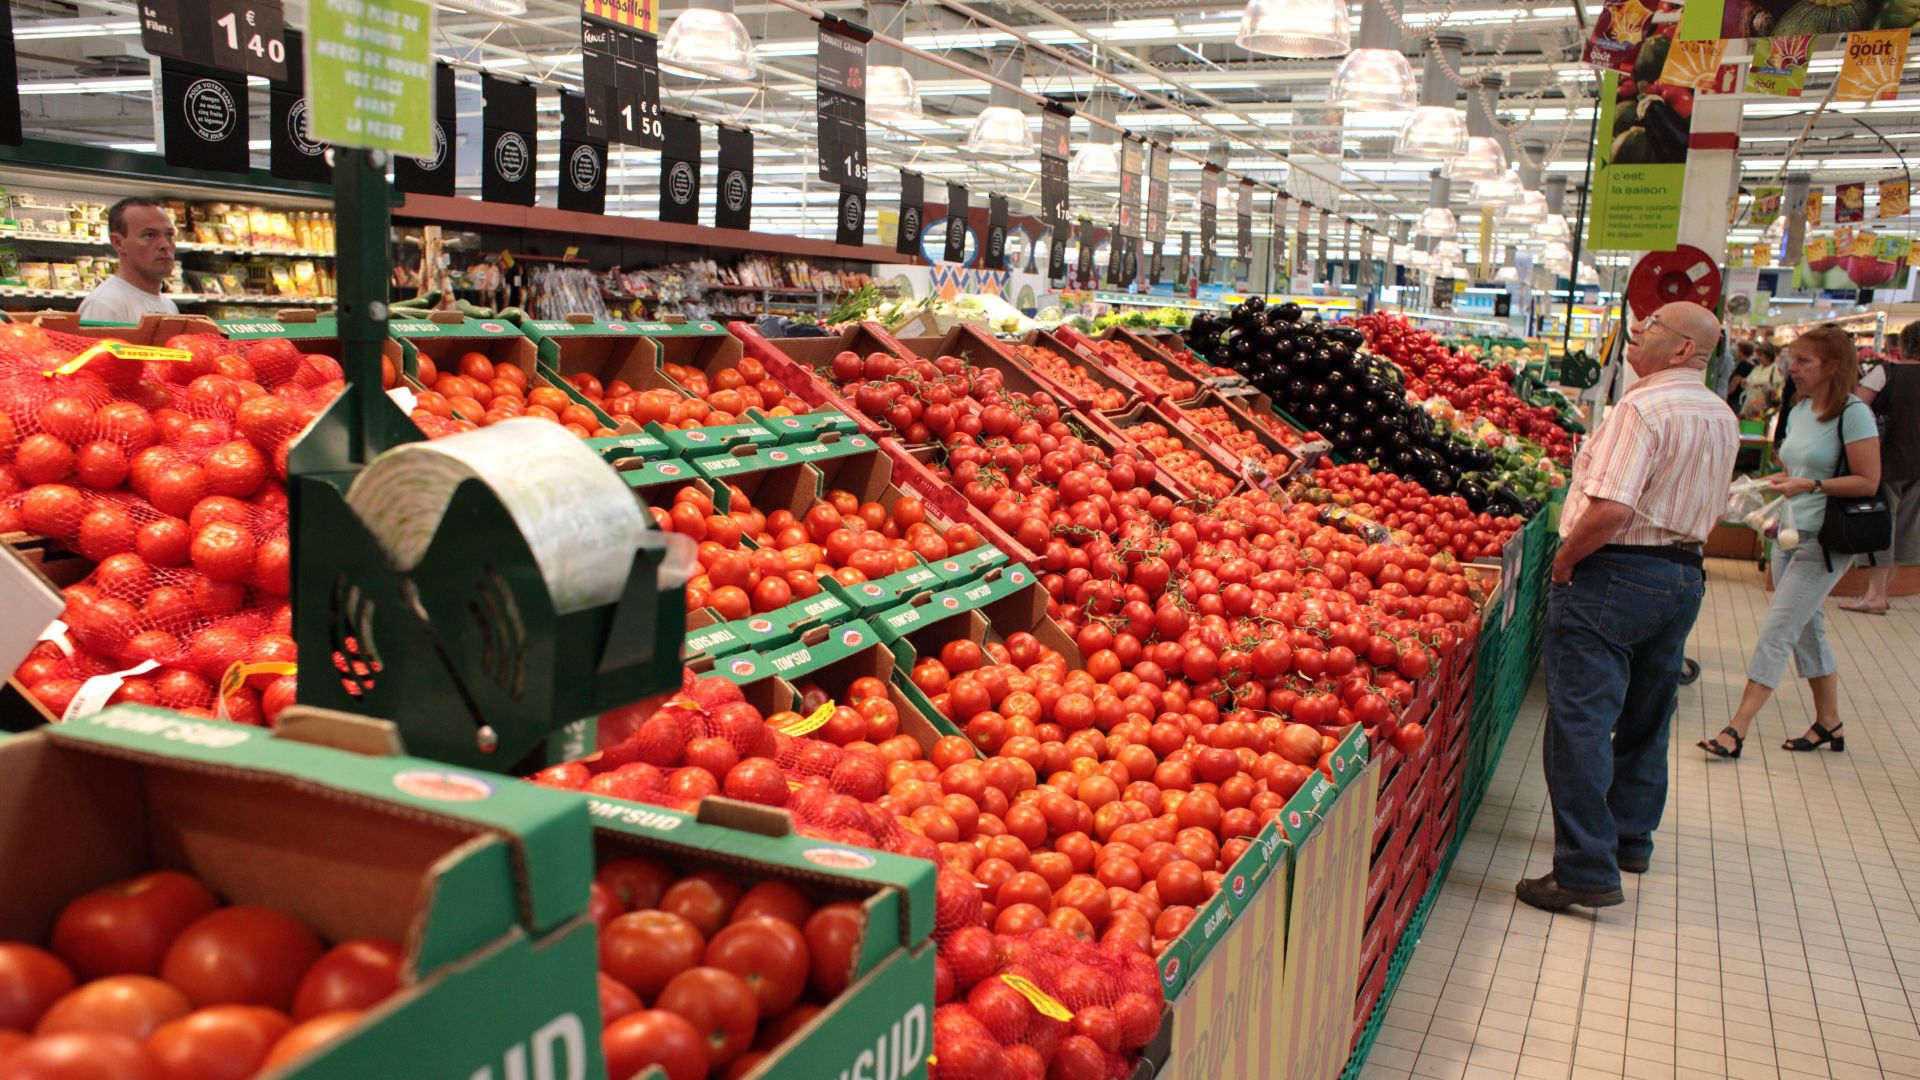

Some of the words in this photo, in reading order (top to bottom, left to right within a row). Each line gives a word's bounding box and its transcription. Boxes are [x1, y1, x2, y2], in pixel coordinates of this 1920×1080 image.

[144, 6, 156, 18] Le
[246, 10, 256, 27] €
[217, 12, 239, 50] 1
[1852, 33, 1867, 44] Du
[248, 34, 286, 63] 40
[820, 32, 843, 49] TOMATE
[1850, 39, 1892, 59] goût
[317, 40, 361, 63] MERCI
[364, 51, 382, 69] DE
[1857, 56, 1863, 66] à
[1867, 56, 1877, 66] la
[1881, 56, 1896, 66] vie
[621, 105, 632, 131] 1
[844, 155, 852, 177] 1
[855, 164, 867, 180] 85
[1624, 185, 1667, 195] saison
[222, 323, 286, 333] TOM'SUD
[924, 501, 941, 517] EXTRA
[771, 649, 812, 671] TOM'SUD
